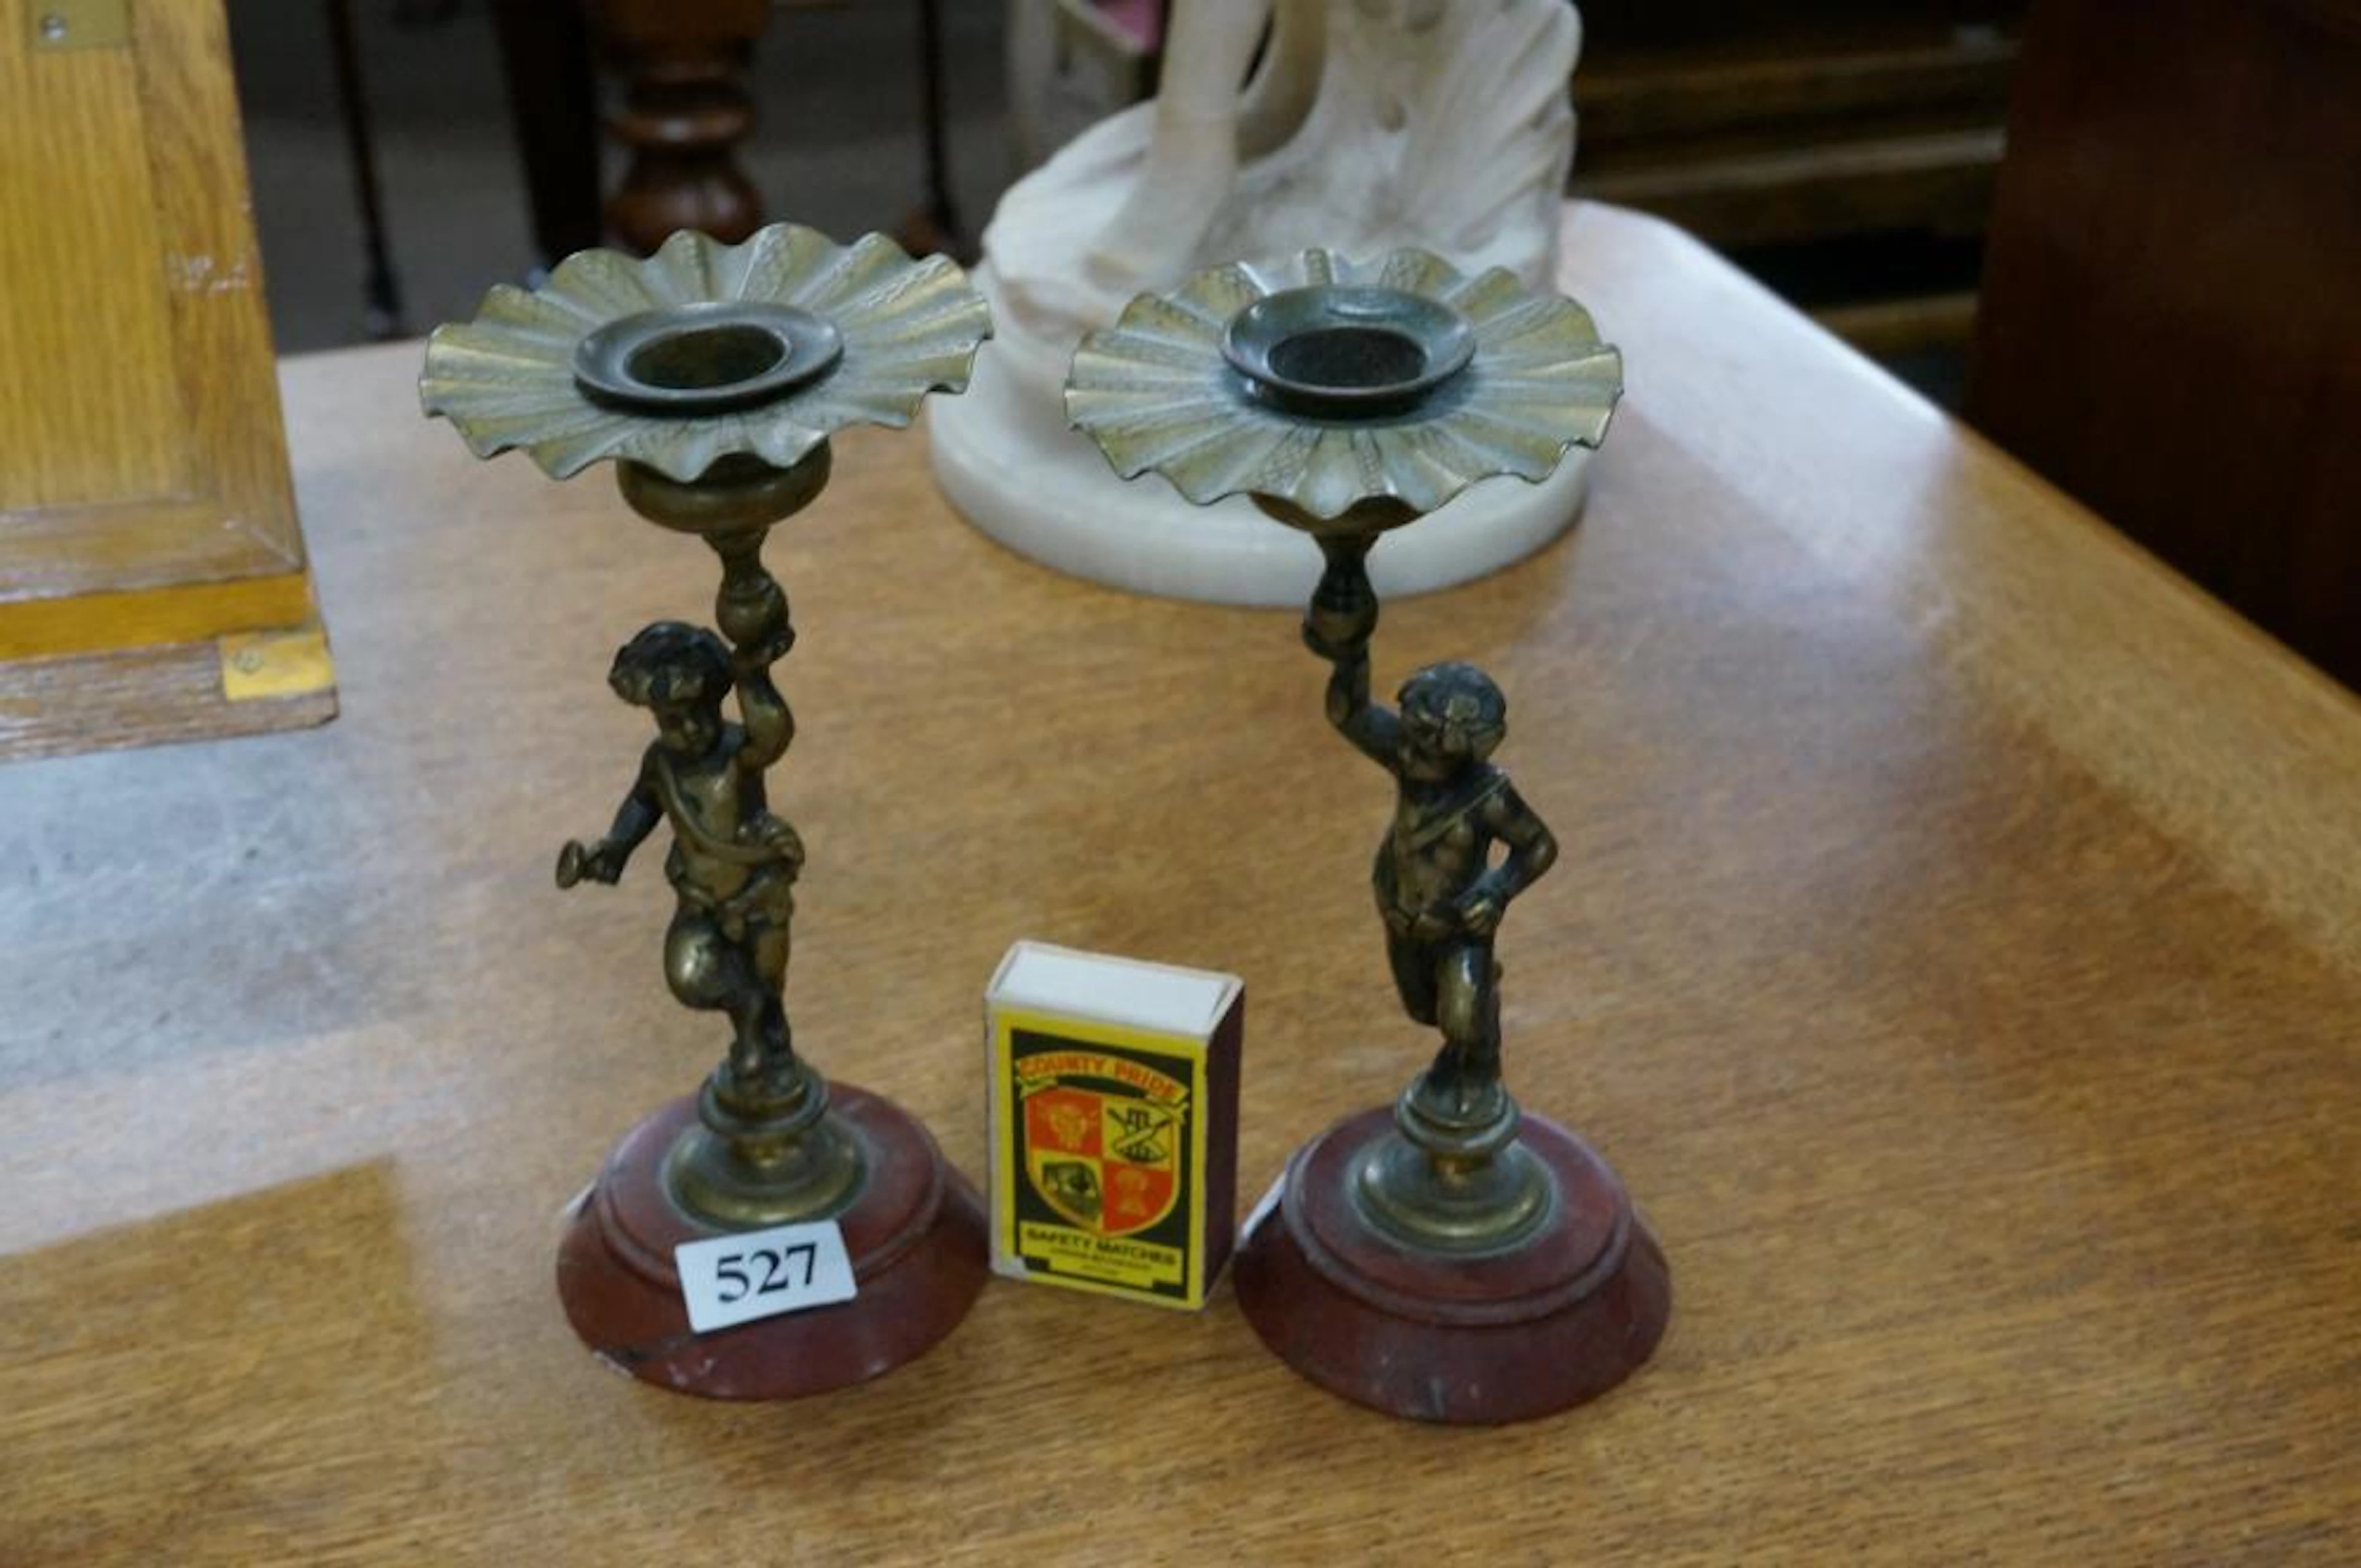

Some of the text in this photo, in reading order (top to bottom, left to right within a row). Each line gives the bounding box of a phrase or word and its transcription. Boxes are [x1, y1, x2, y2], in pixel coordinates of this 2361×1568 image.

[1019, 1055, 1180, 1098] COUNTY PRIDE
[1026, 1227, 1091, 1251] SAFETY
[1096, 1237, 1177, 1266] MATCHES
[717, 1242, 817, 1303] 527
